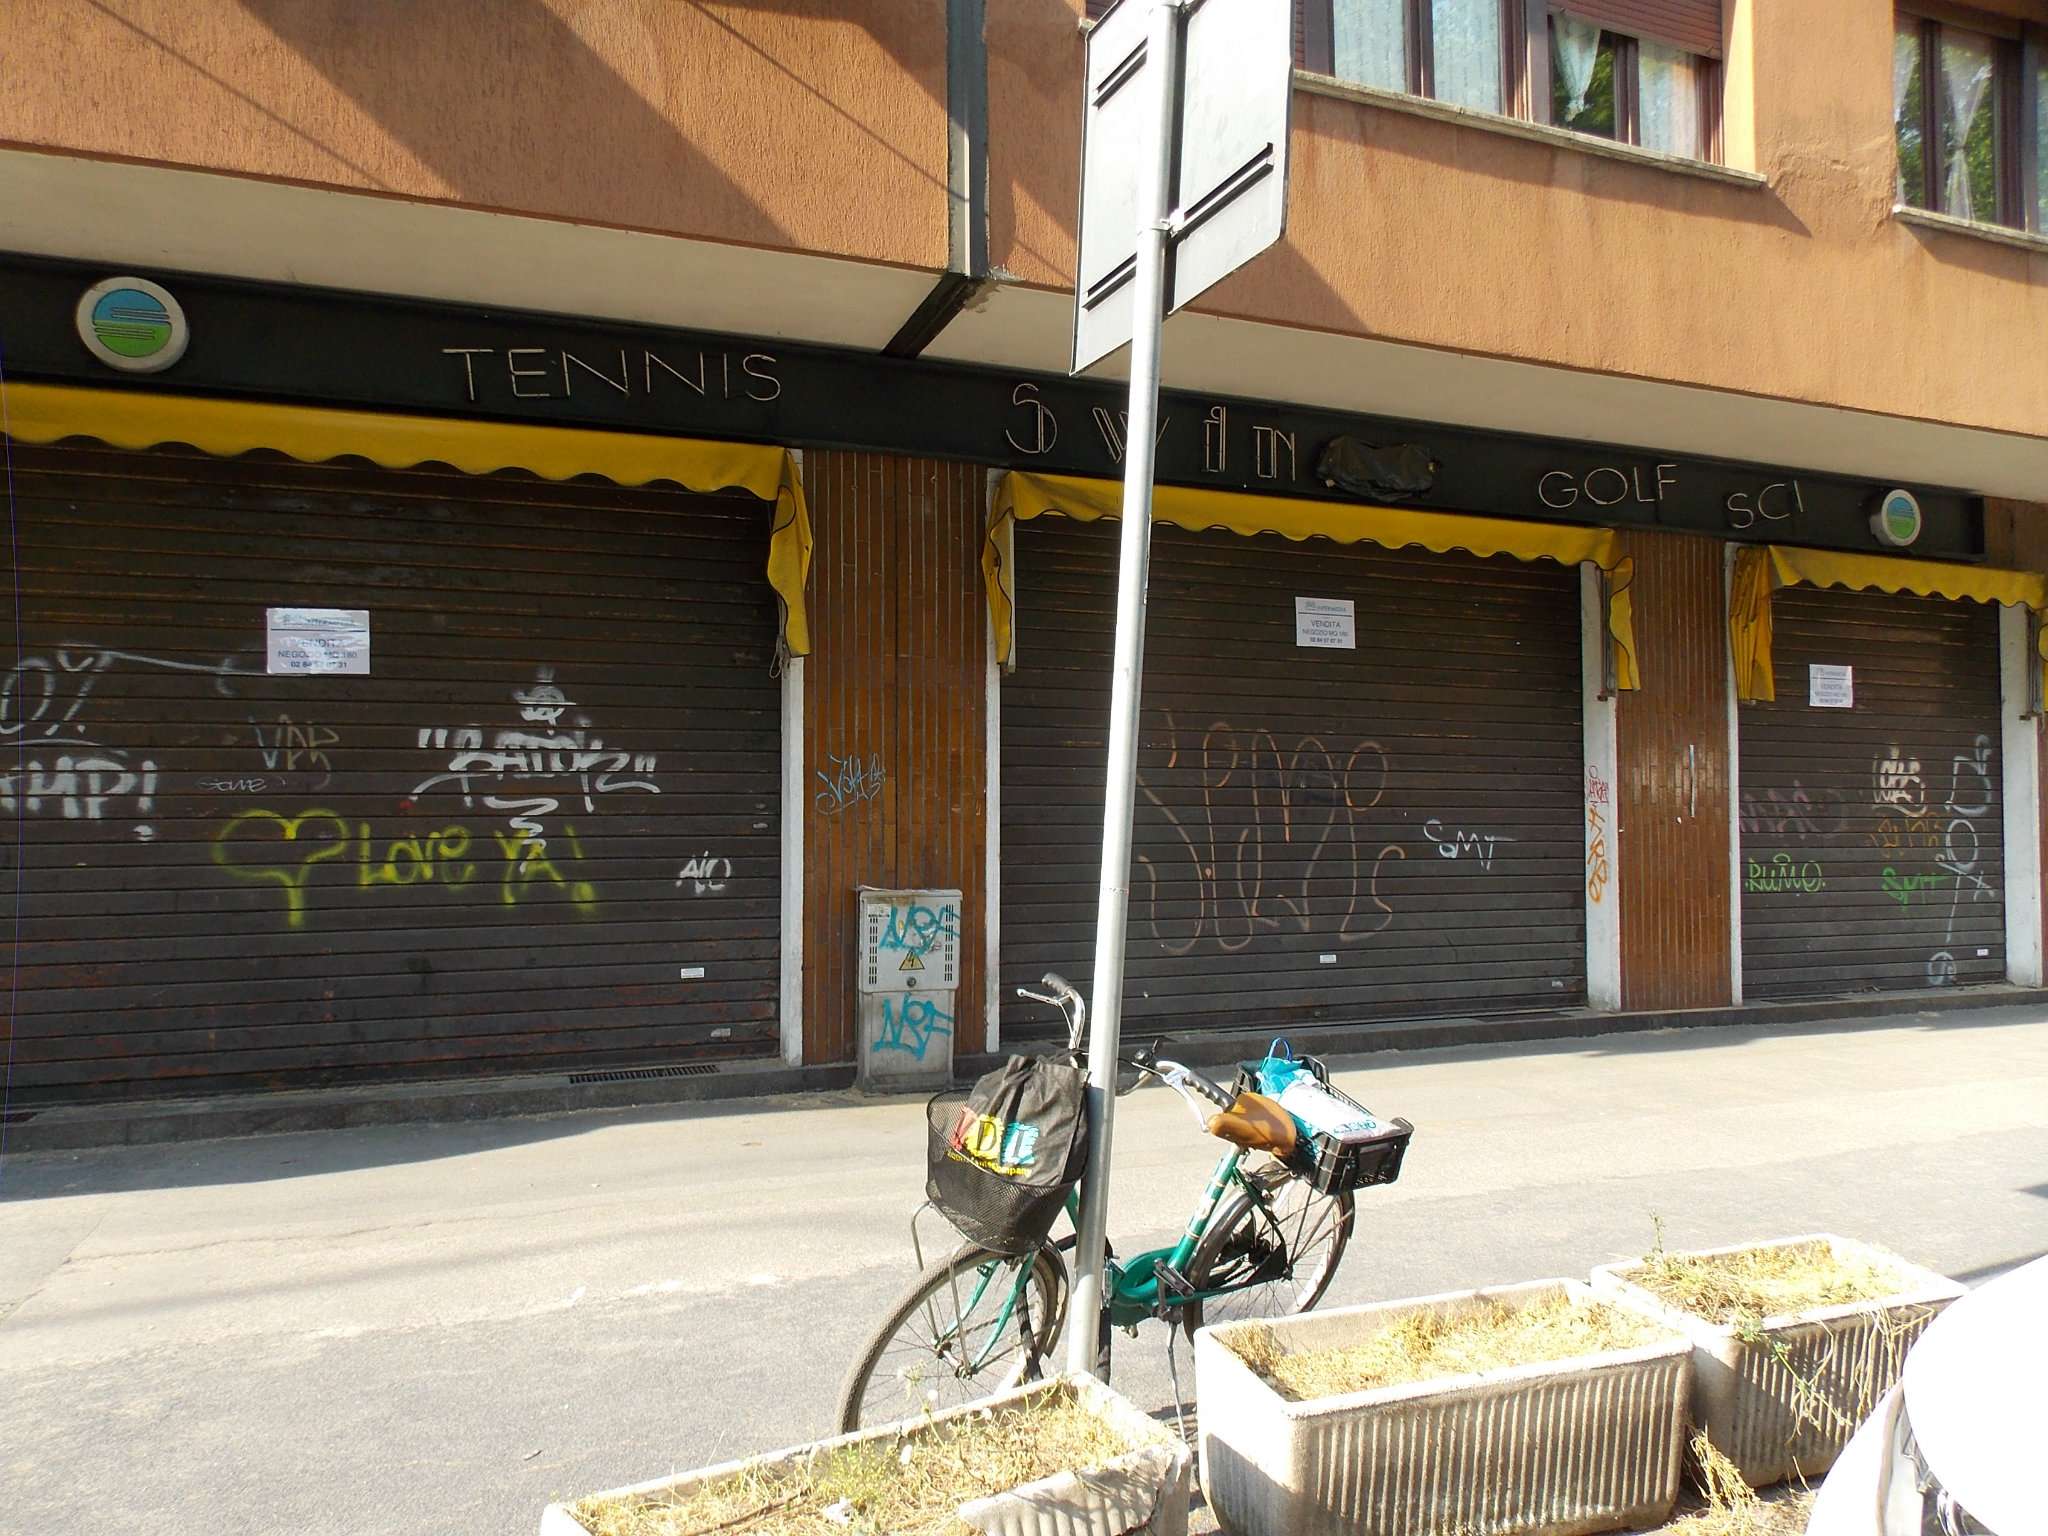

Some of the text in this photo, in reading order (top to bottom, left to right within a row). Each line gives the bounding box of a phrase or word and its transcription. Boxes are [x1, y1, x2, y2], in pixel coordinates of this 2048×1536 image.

[442, 347, 781, 402] TENNIS
[1537, 463, 1805, 529] GOLF SCI
[1311, 620, 1342, 629] VENDITA
